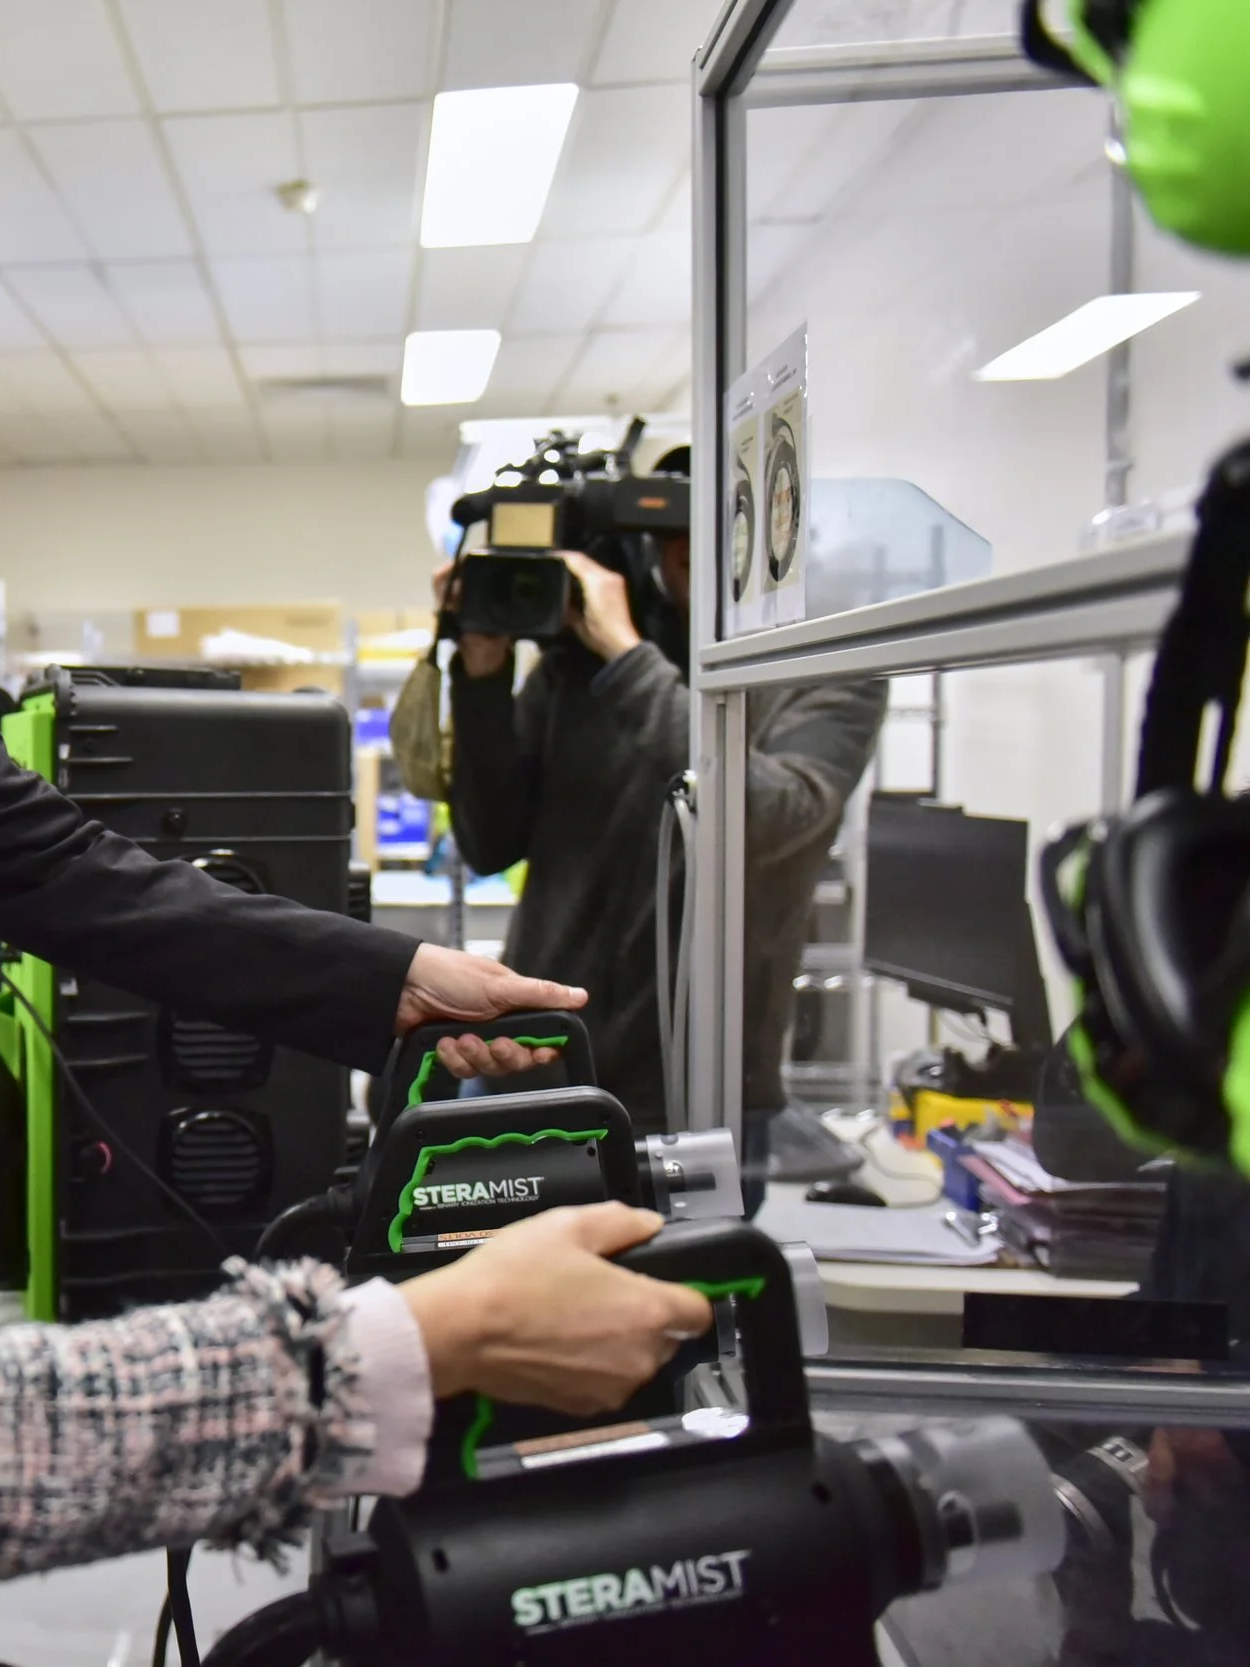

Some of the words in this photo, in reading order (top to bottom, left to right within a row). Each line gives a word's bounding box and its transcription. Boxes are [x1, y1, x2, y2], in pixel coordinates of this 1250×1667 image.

[413, 1177, 541, 1206] STERAMIST
[498, 1195, 539, 1204] TECHNOLOGY
[511, 1549, 750, 1626] STERAMIST
